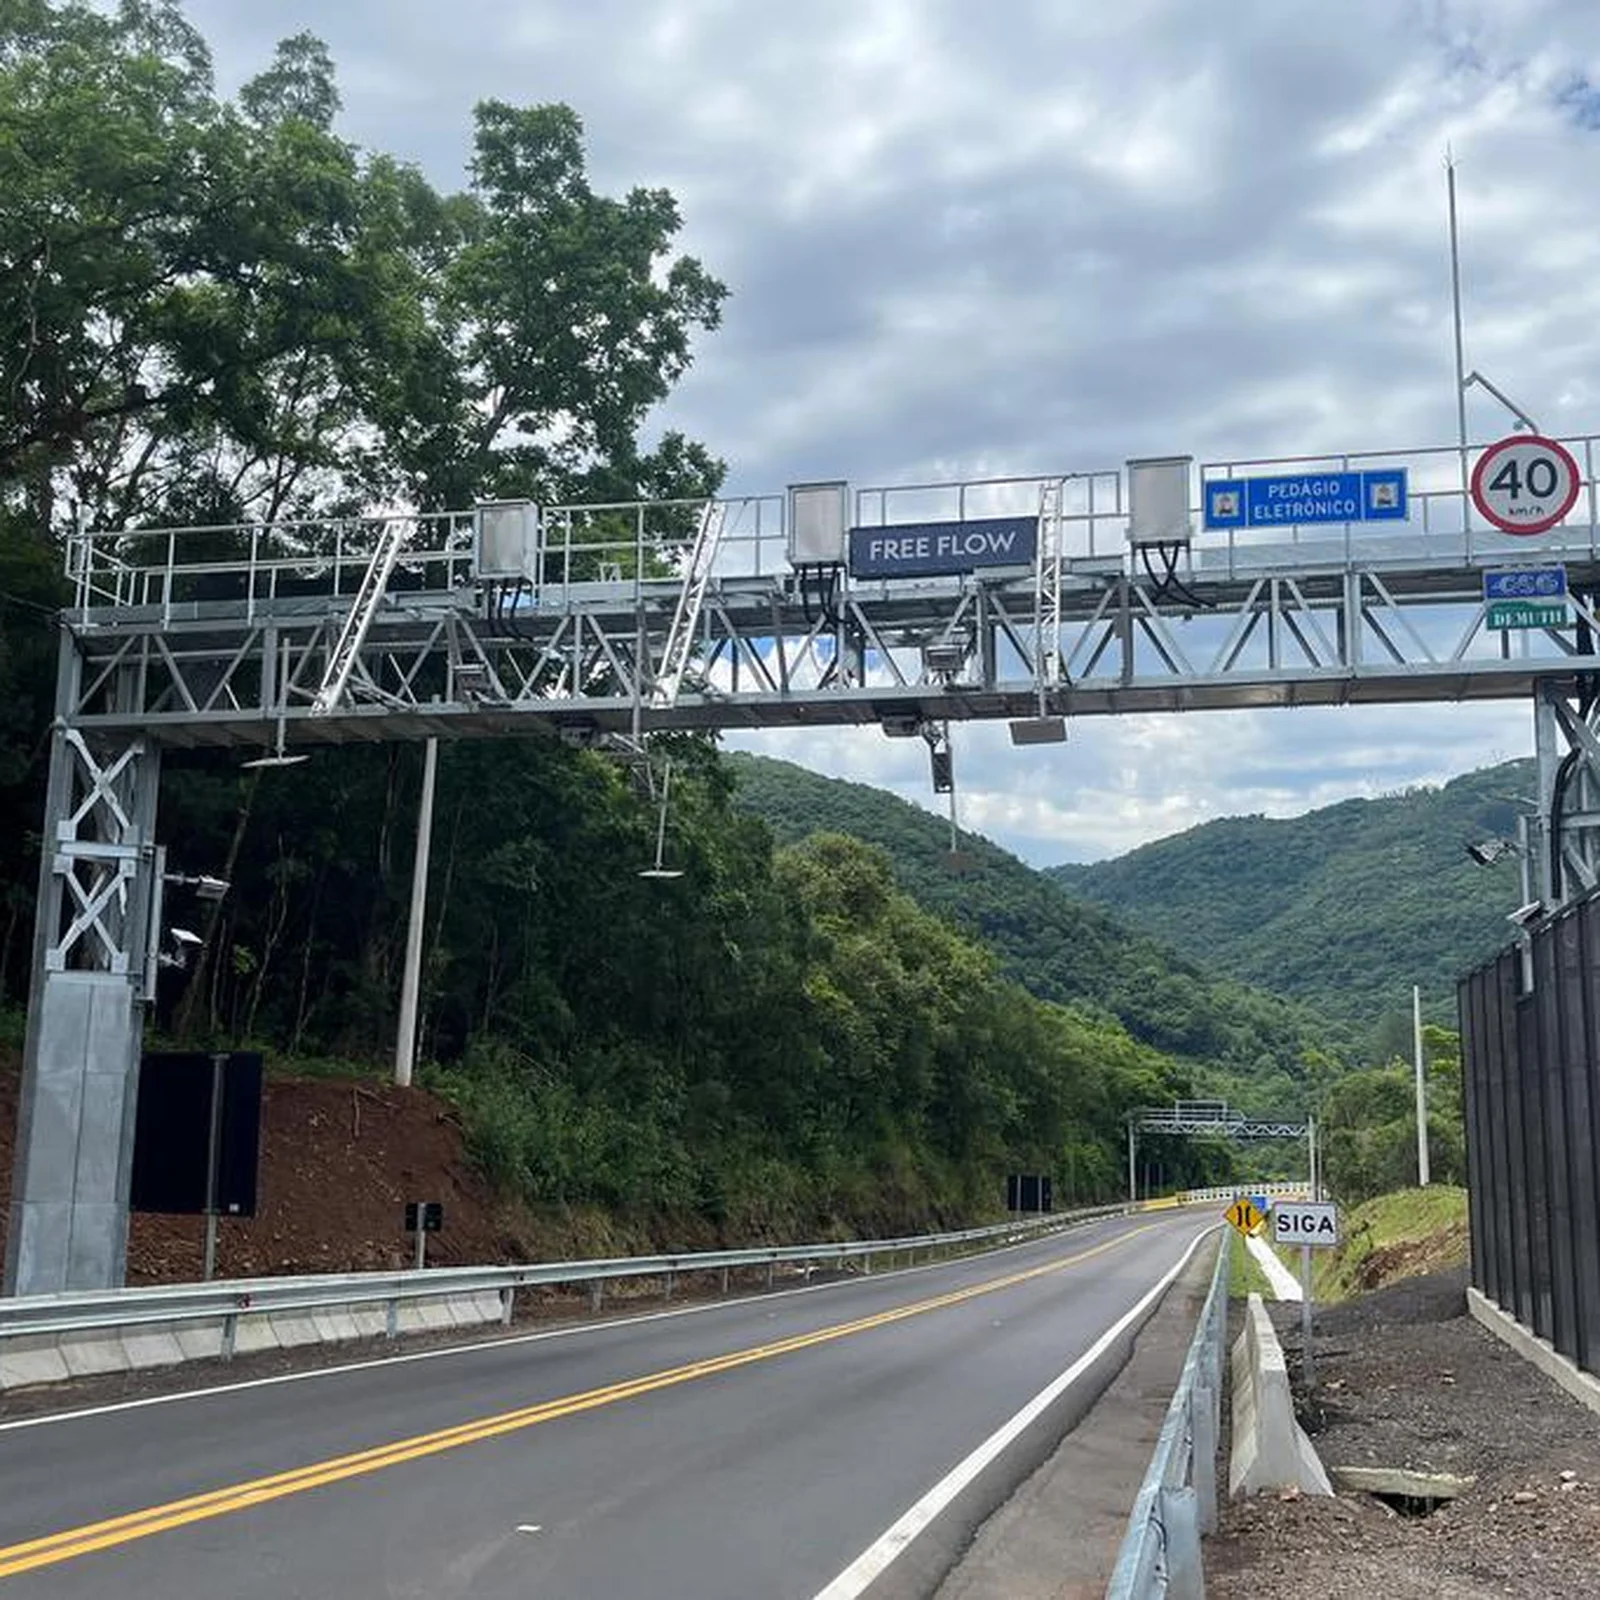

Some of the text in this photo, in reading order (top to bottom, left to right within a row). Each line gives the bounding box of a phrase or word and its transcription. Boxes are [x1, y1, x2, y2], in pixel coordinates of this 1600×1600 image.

[1268, 476, 1340, 498] PEDÁGIO
[1488, 457, 1558, 499] 40
[1253, 498, 1356, 520] ELETRÔNICO
[1508, 505, 1545, 517] km/h
[869, 531, 1016, 561] FREE FLOW
[1277, 1213, 1335, 1234] SIGA
